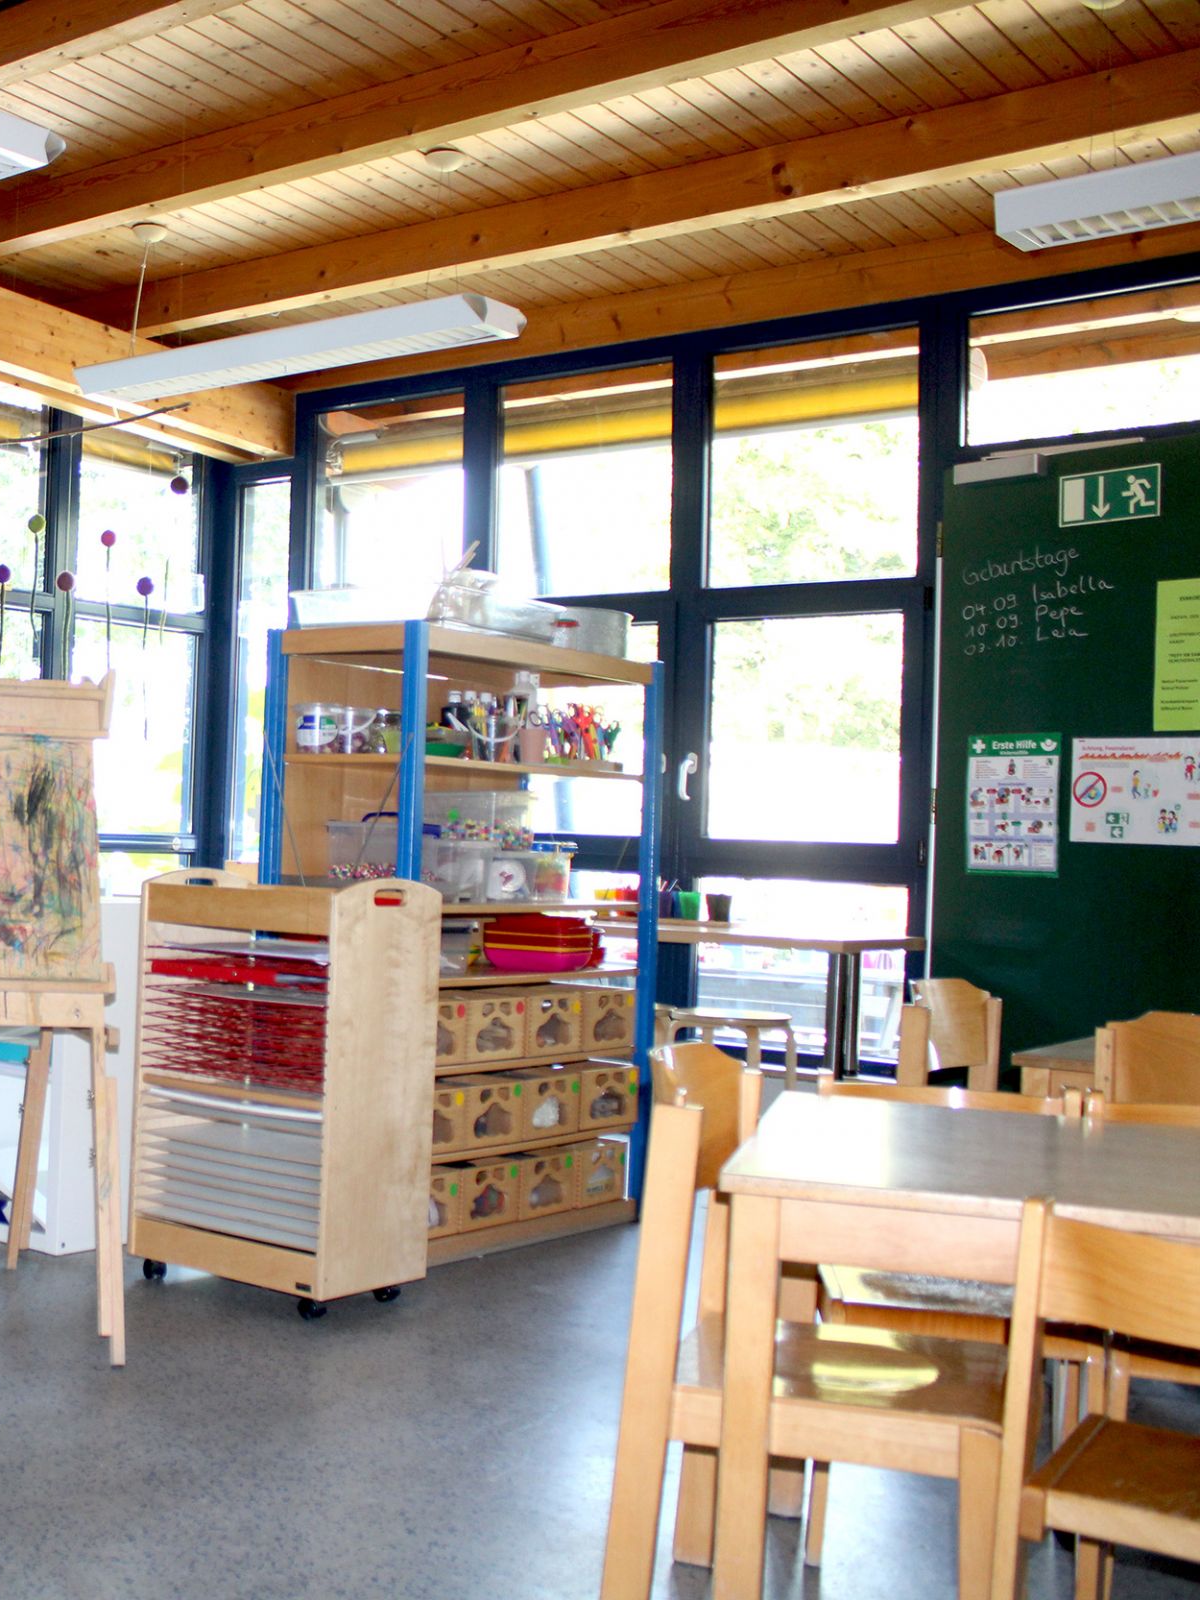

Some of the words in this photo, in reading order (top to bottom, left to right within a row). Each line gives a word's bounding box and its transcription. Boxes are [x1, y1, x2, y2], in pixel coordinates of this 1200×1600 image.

[962, 545, 1080, 586] Geburtstage
[1032, 576, 1115, 605] Isabella
[1035, 604, 1084, 628] Pepe
[992, 740, 1015, 750] Erste
[1015, 740, 1037, 750] Hilfe
